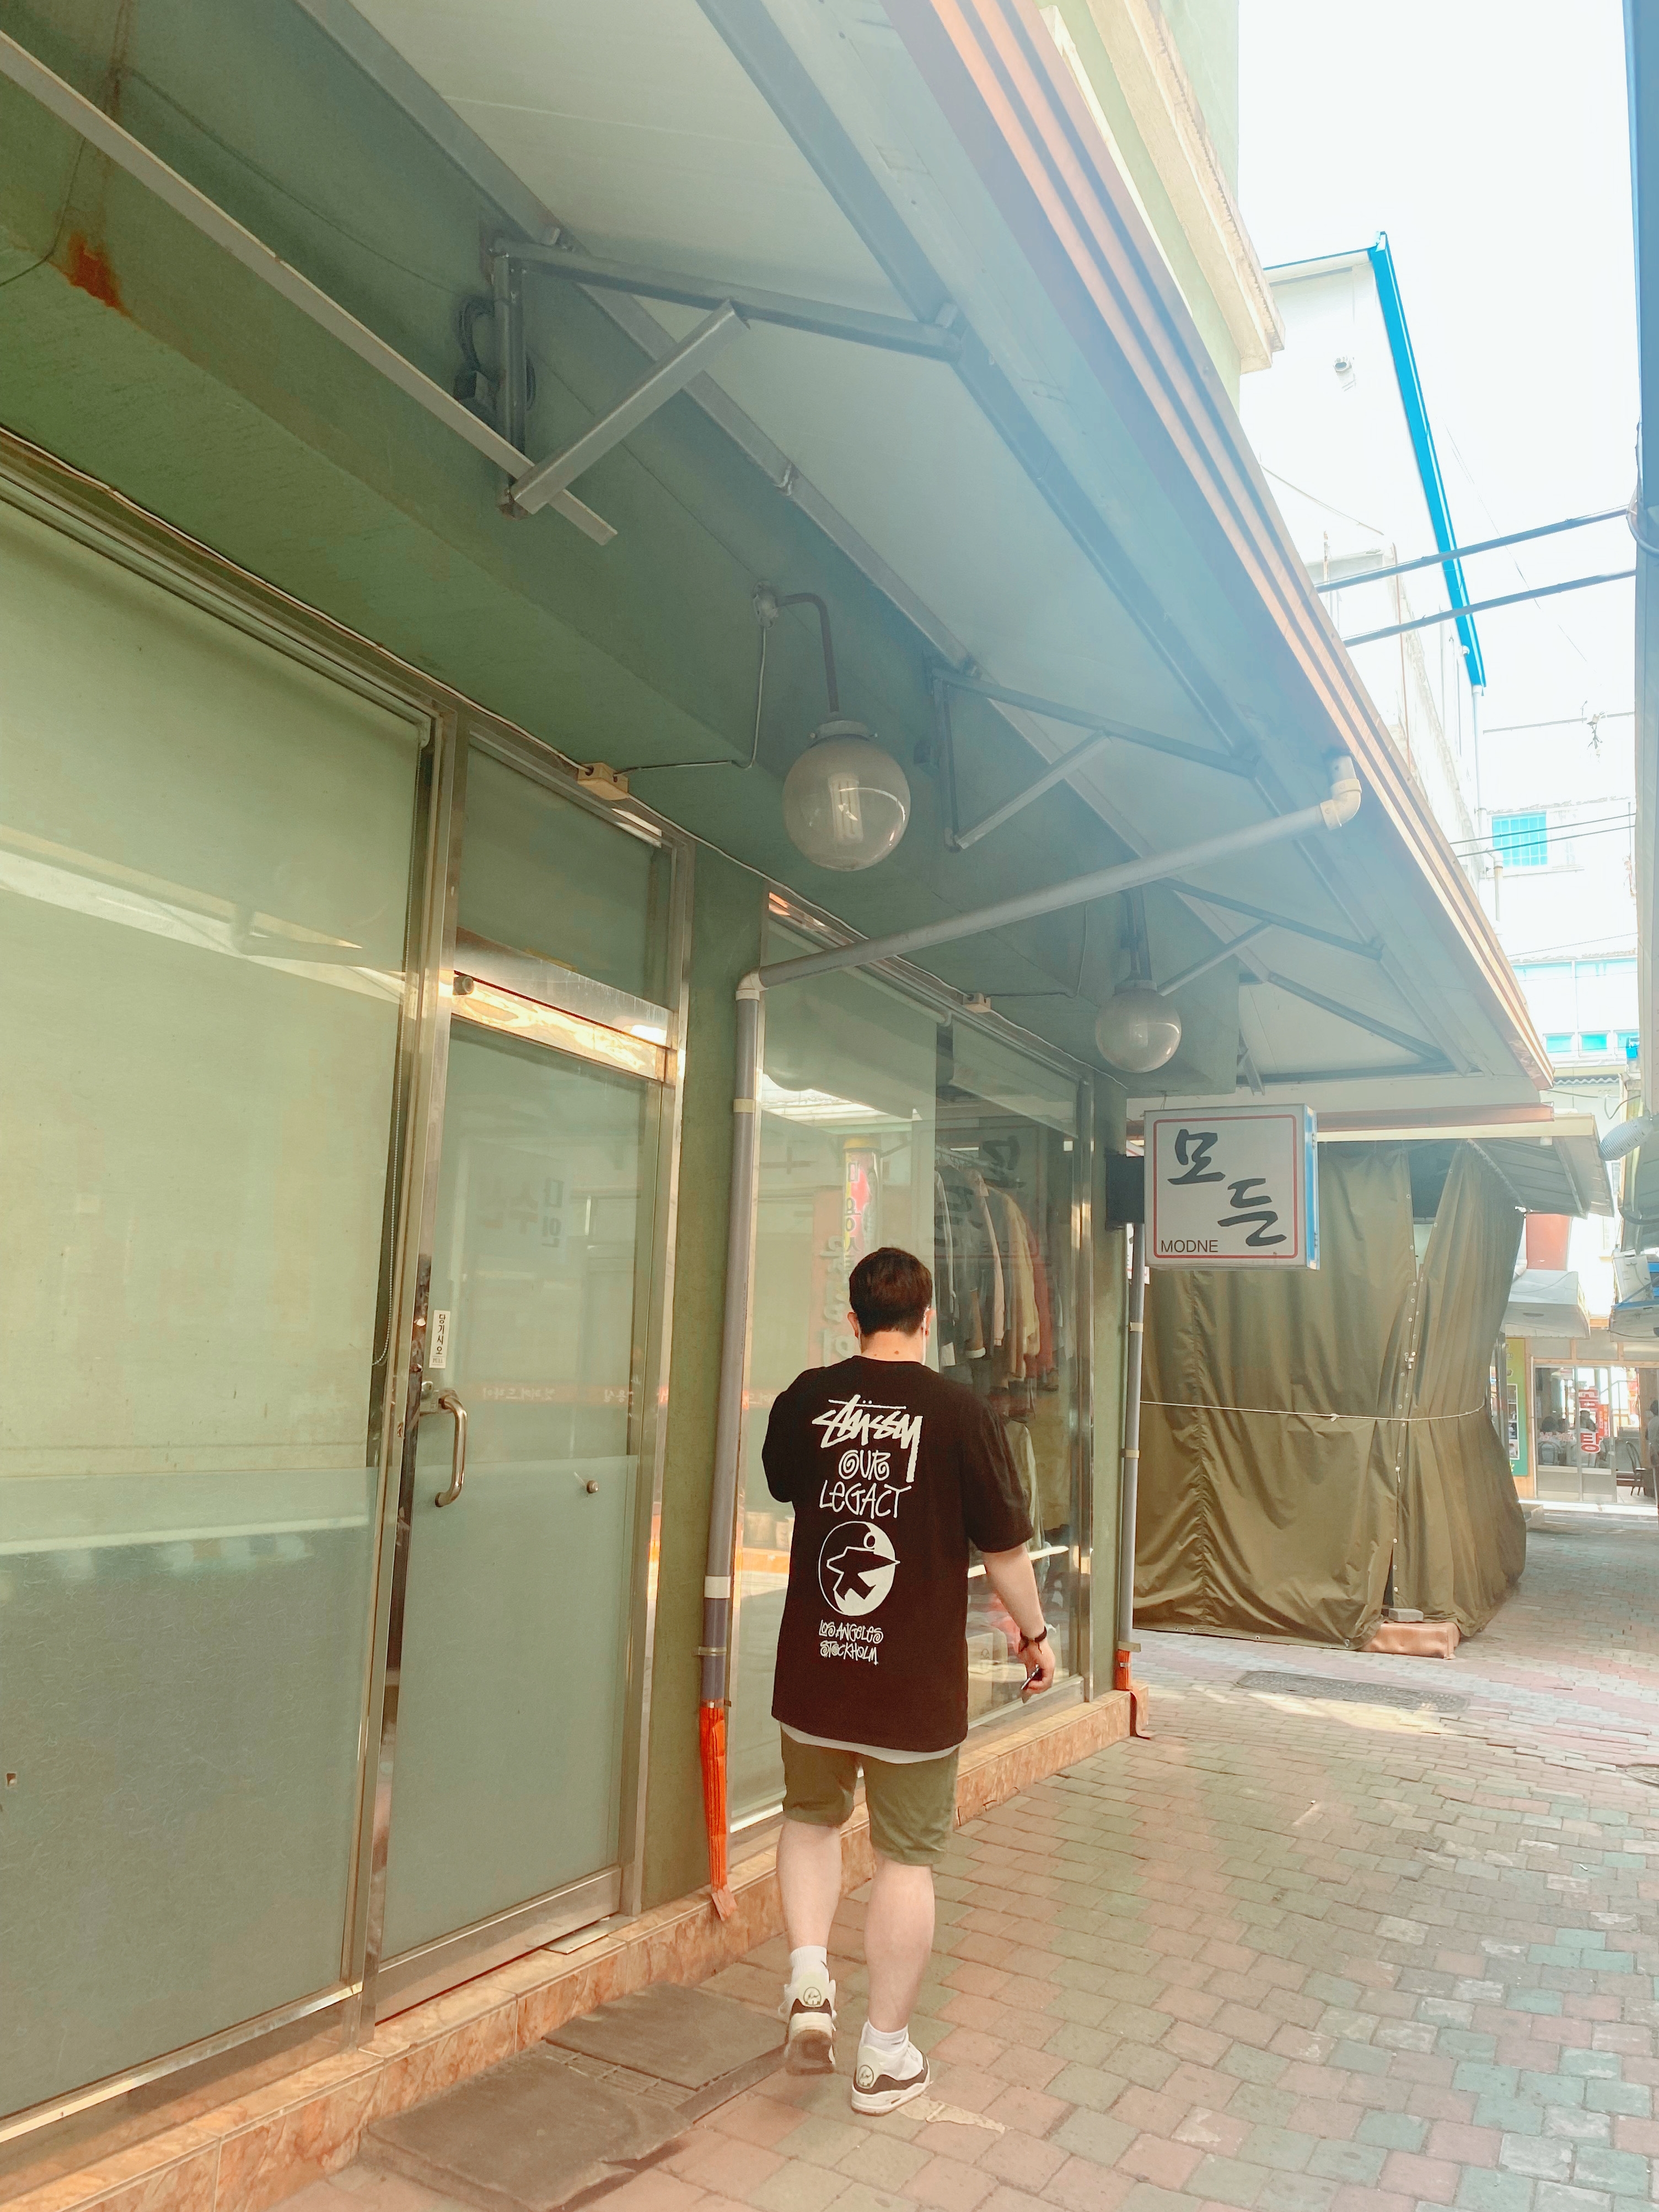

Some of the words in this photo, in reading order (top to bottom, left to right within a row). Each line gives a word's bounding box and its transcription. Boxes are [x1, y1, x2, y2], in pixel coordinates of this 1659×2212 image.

[1161, 1239, 1218, 1253] MODNE
[435, 1314, 446, 1355] 당기시오
[838, 1449, 891, 1481] OUR
[820, 1639, 878, 1666] STOCKHOLM
